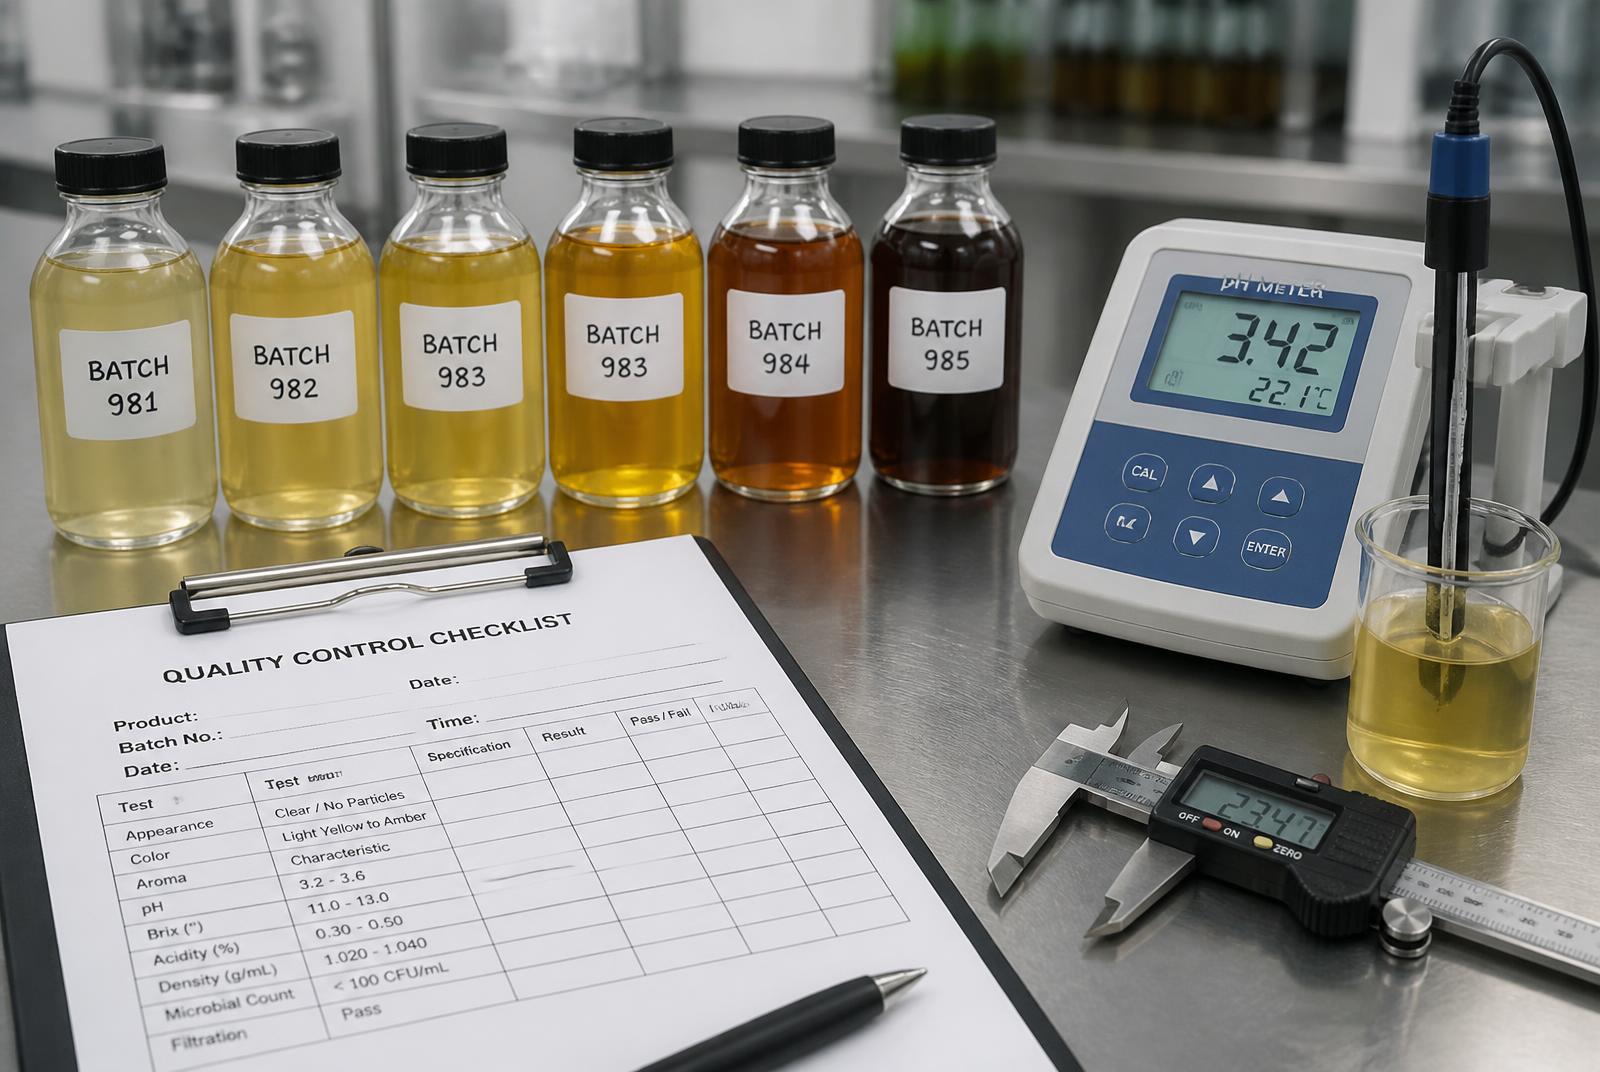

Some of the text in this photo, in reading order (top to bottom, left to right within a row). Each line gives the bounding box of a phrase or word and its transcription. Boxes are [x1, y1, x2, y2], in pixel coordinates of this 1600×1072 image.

[587, 324, 660, 345] BATCH
[749, 320, 821, 341] BATCH
[911, 318, 982, 338] BATCH
[423, 333, 497, 354] BATCH
[1217, 312, 1339, 375] 3.42
[253, 344, 330, 366] BATCH
[763, 353, 810, 375] 984
[924, 350, 970, 371] 985
[88, 355, 169, 382] BATCH
[437, 366, 486, 388] 983
[601, 357, 648, 378] 983
[270, 378, 319, 400] 982
[107, 391, 158, 417] 981
[1131, 465, 1157, 481] CAL
[1247, 541, 1287, 558] ENTER
[163, 613, 573, 683] QUALITY CONTROL CHECKLIST
[409, 675, 460, 690] Date:
[113, 711, 198, 732] Product:
[426, 713, 480, 730] Time:
[630, 714, 660, 726] Pass
[118, 730, 223, 754] Batch No.:
[542, 726, 587, 743] Result
[427, 740, 511, 762] Specification
[124, 760, 180, 778] Date:
[265, 775, 300, 790] Test
[118, 799, 154, 813] Test
[275, 805, 310, 819] Clear
[324, 801, 343, 811] No
[347, 790, 405, 807] Particles
[282, 812, 427, 843] Light Yellow to Amber
[1178, 811, 1200, 824] OFF
[1217, 792, 1317, 844] 23.47
[126, 818, 214, 842] Appearance
[1223, 827, 1240, 838] ON
[130, 851, 170, 865] Color
[291, 842, 391, 866] Characteristic
[1273, 844, 1303, 860] ZERO
[136, 873, 187, 890] Aroma
[299, 877, 324, 890] 3.2
[341, 870, 365, 884] 3.6
[142, 901, 164, 917] pH
[308, 899, 340, 914] 11.0
[357, 891, 389, 906] 13.0
[148, 926, 179, 941] Brix
[315, 924, 351, 940] 0.30
[368, 915, 403, 930] 0.50
[153, 942, 240, 967] Acidity (%)
[324, 948, 368, 966] 1.020
[385, 937, 427, 955] 1.040
[159, 963, 278, 994] Density (g/mL)
[351, 974, 379, 990] 100
[384, 962, 450, 983] CFU/mL
[165, 988, 295, 1022] Microbial Count
[341, 1004, 382, 1021] Pass
[171, 1029, 248, 1052] Filtration
